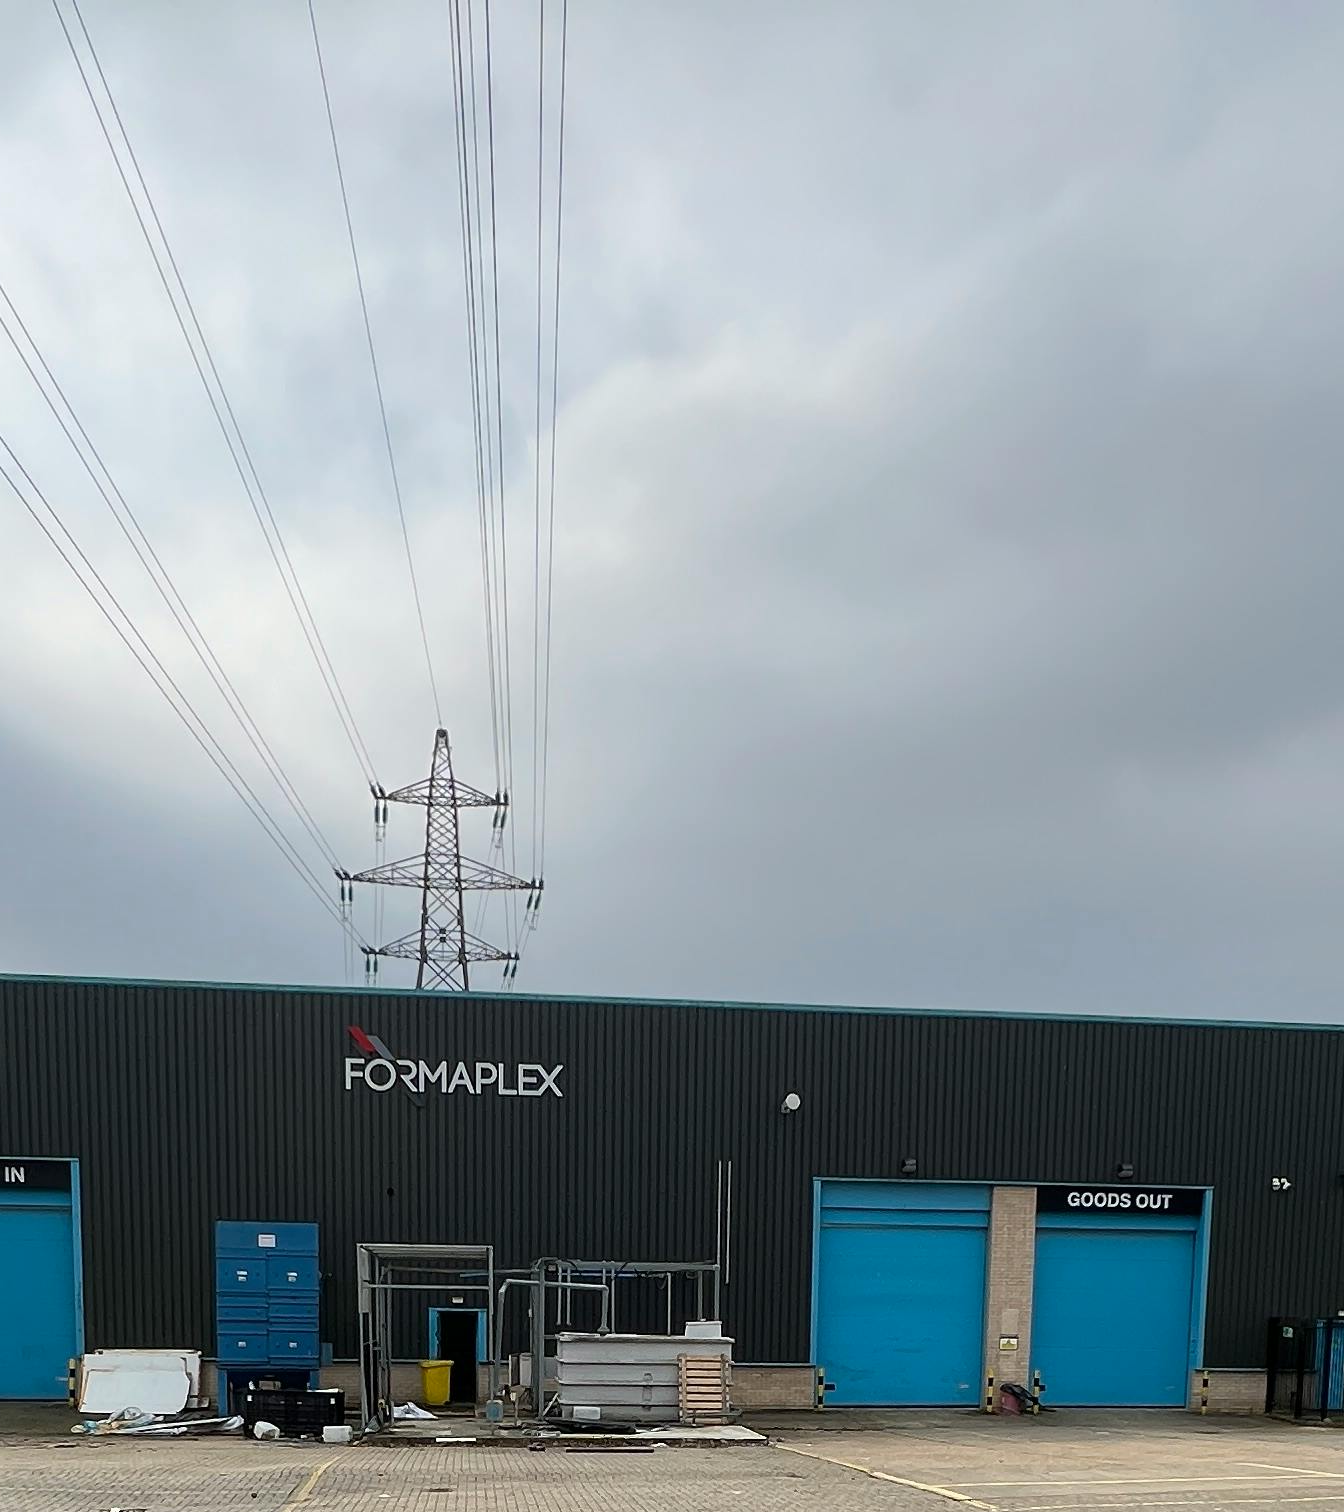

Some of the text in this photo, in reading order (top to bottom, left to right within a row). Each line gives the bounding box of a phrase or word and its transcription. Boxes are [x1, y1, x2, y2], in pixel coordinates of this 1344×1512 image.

[345, 1057, 564, 1097] FORMAPLEX
[4, 1166, 25, 1183] IN
[1067, 1191, 1173, 1209] GOODS OUT
